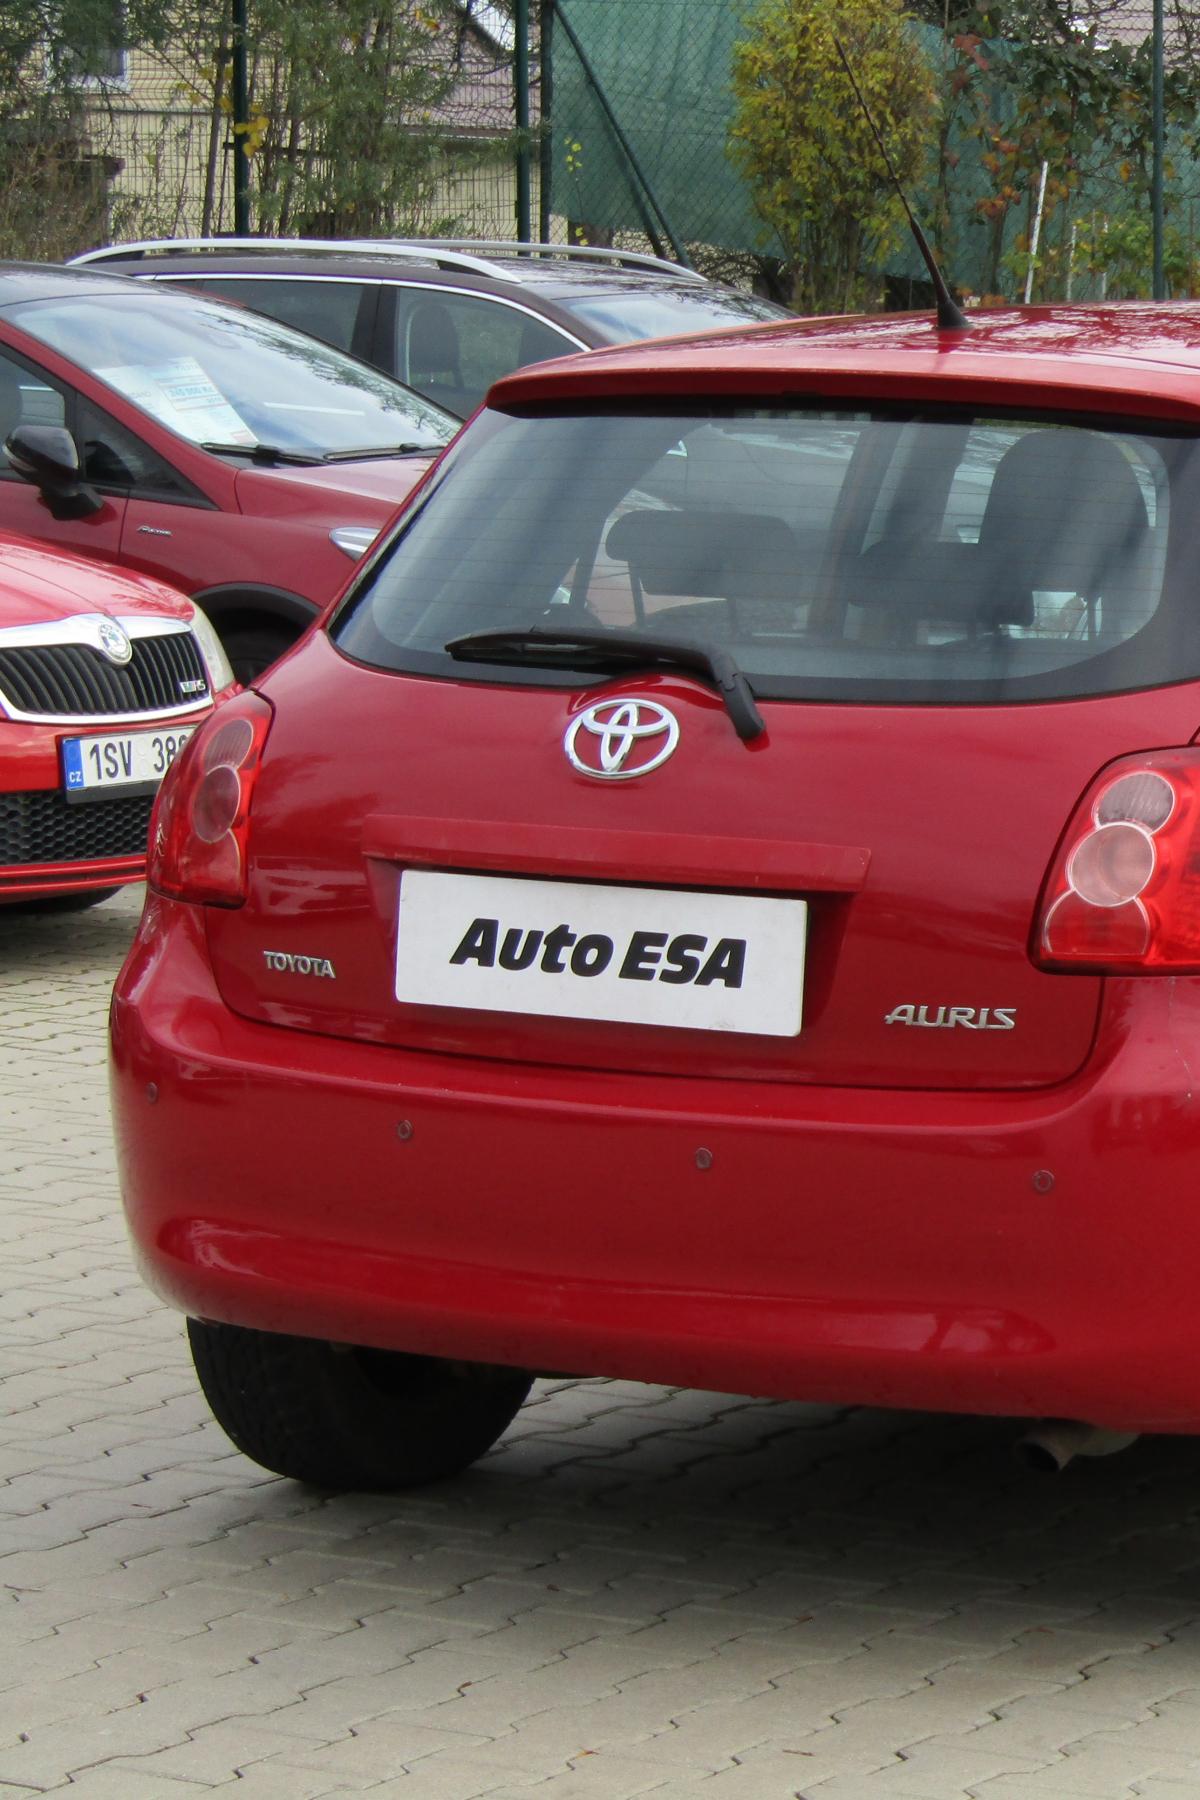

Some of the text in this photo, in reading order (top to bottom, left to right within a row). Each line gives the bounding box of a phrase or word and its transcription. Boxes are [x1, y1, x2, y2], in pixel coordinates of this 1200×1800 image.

[90, 740, 132, 780] 1SV
[69, 770, 83, 783] CZ
[263, 950, 337, 979] TOYOTA
[449, 917, 748, 989] Auto ESA
[884, 1004, 1017, 1030] AURIS
